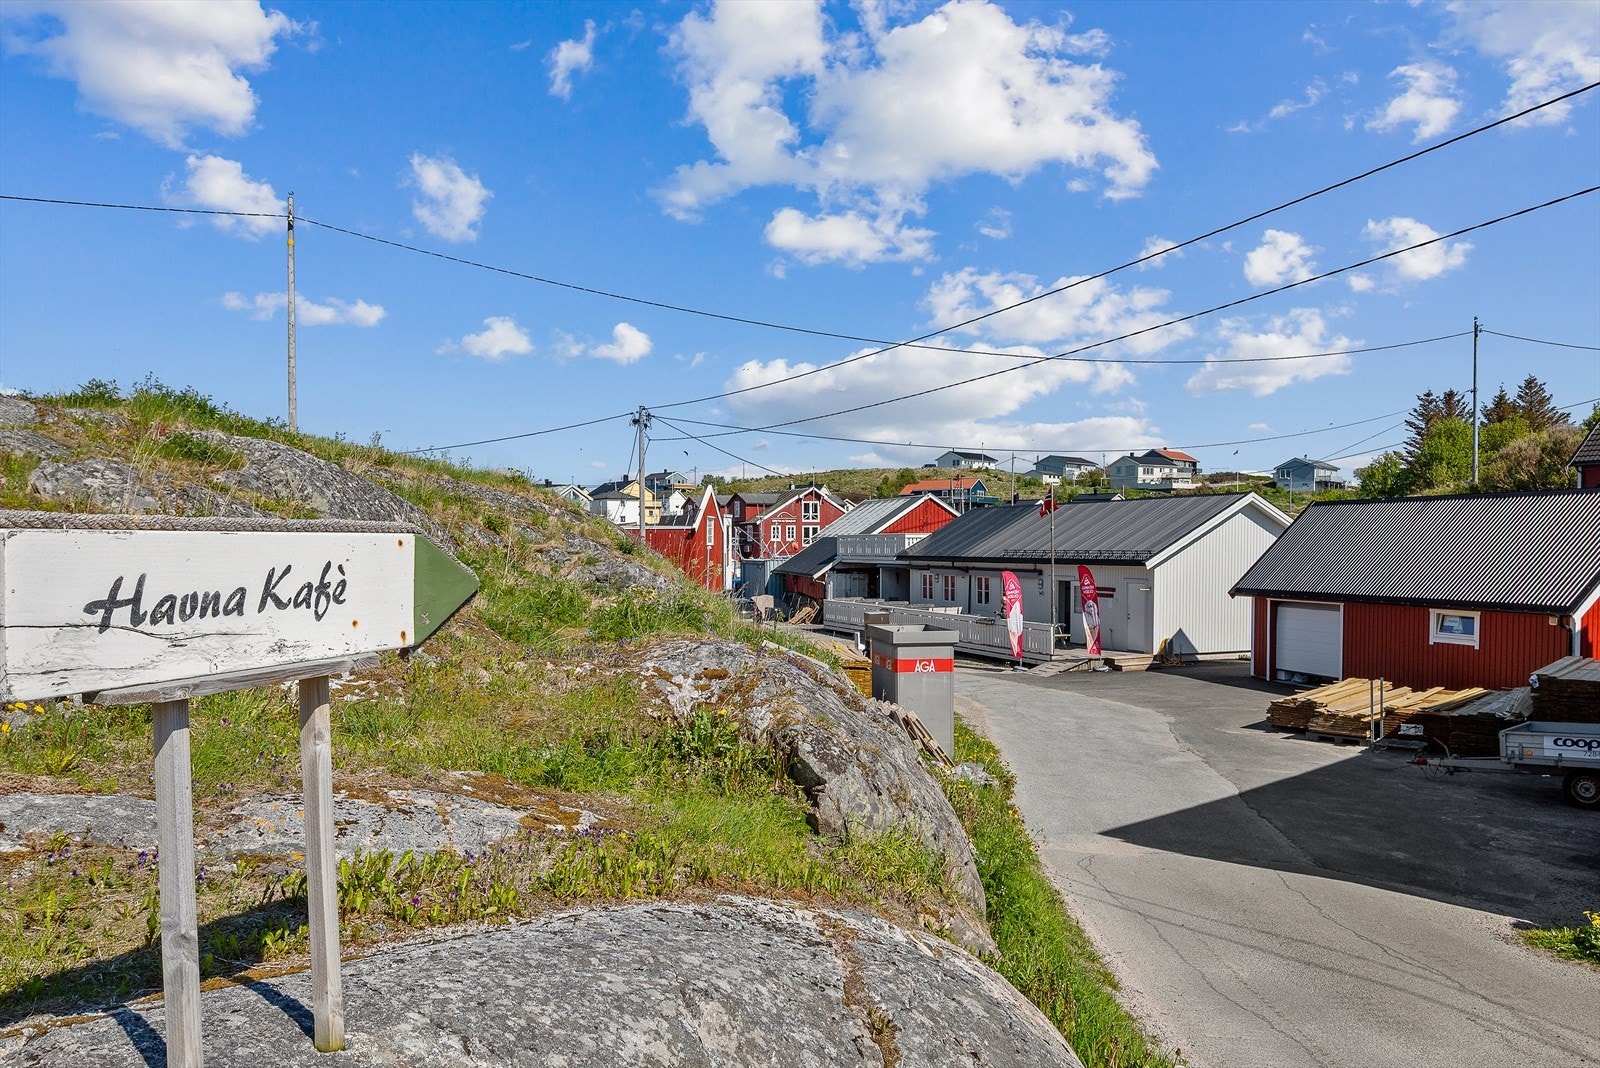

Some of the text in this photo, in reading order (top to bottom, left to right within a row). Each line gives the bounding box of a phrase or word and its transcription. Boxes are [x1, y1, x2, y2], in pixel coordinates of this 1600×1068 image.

[257, 560, 348, 622] Kafè
[914, 659, 936, 673] AGA
[1552, 737, 1600, 751] coop
